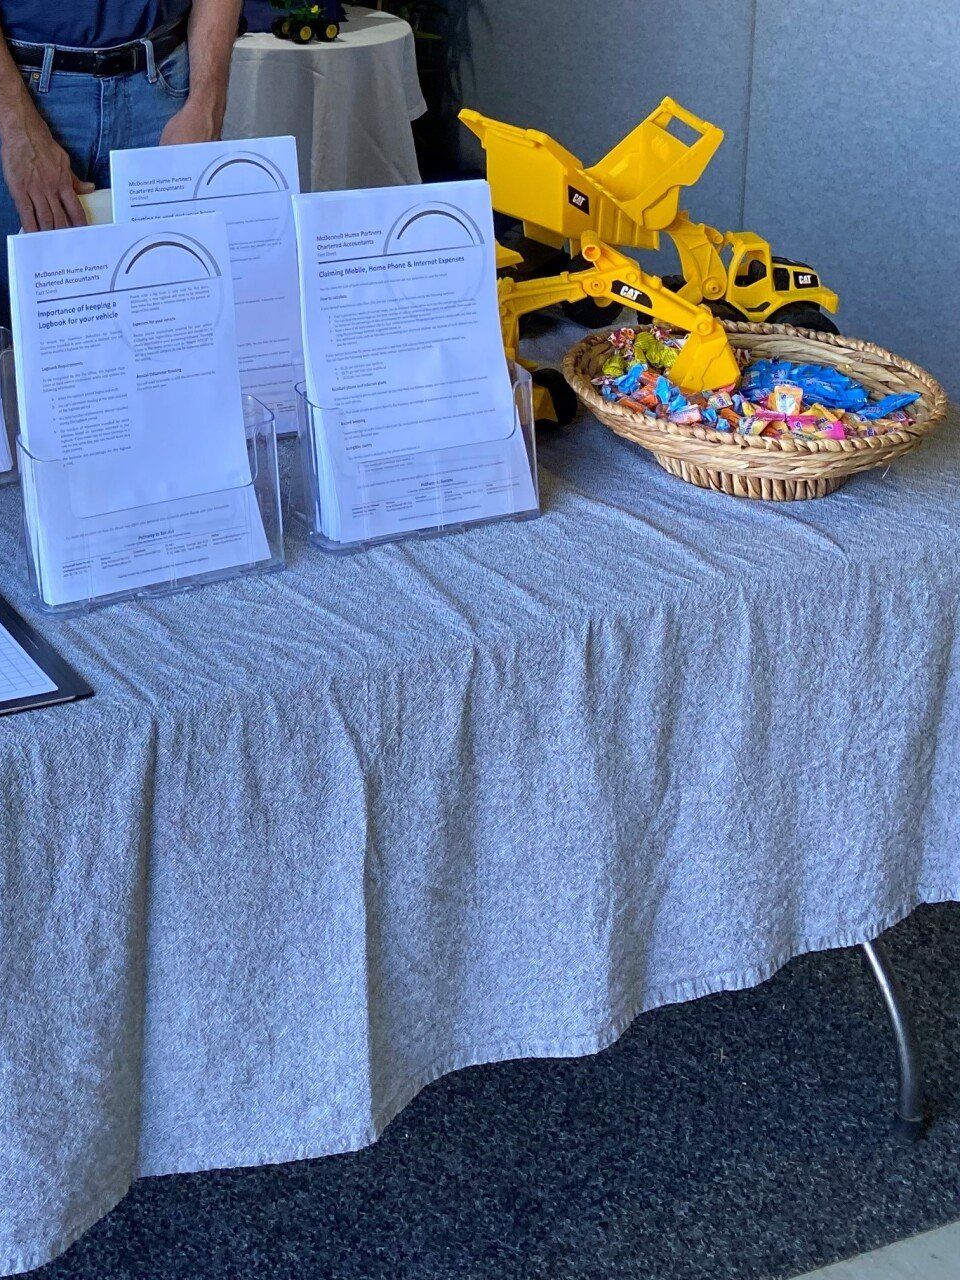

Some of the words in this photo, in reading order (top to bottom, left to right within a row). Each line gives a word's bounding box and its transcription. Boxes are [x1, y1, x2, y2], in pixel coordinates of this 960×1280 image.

[128, 178, 155, 187] McDonnell
[171, 176, 192, 184] Partners
[129, 186, 154, 195] Chartered
[154, 184, 184, 193] Accountants
[572, 193, 586, 207] CAT
[316, 233, 343, 242] McDonnell
[344, 231, 360, 240] Hume
[360, 229, 382, 238] Partners
[316, 241, 342, 251] Chartered
[342, 238, 374, 248] Accountants
[34, 269, 66, 279] McDonnell
[66, 266, 84, 276] Hume
[84, 263, 108, 273] Partners
[318, 267, 344, 278] Claiming
[344, 265, 367, 276] Mobile,
[368, 263, 386, 272] Home
[387, 261, 406, 271] Phone
[407, 260, 413, 268] &
[413, 258, 438, 267] Internet
[438, 255, 465, 265] Expenses
[35, 279, 64, 289] Chartered
[64, 274, 100, 285] Accountants
[798, 275, 812, 284] CAT
[619, 285, 641, 301] CAT
[37, 307, 76, 320] Importance
[77, 305, 85, 313] of
[85, 301, 112, 314] keeping
[38, 317, 68, 330] Logbook
[68, 316, 78, 325] for
[78, 314, 95, 325] your
[95, 311, 119, 322] vehicle
